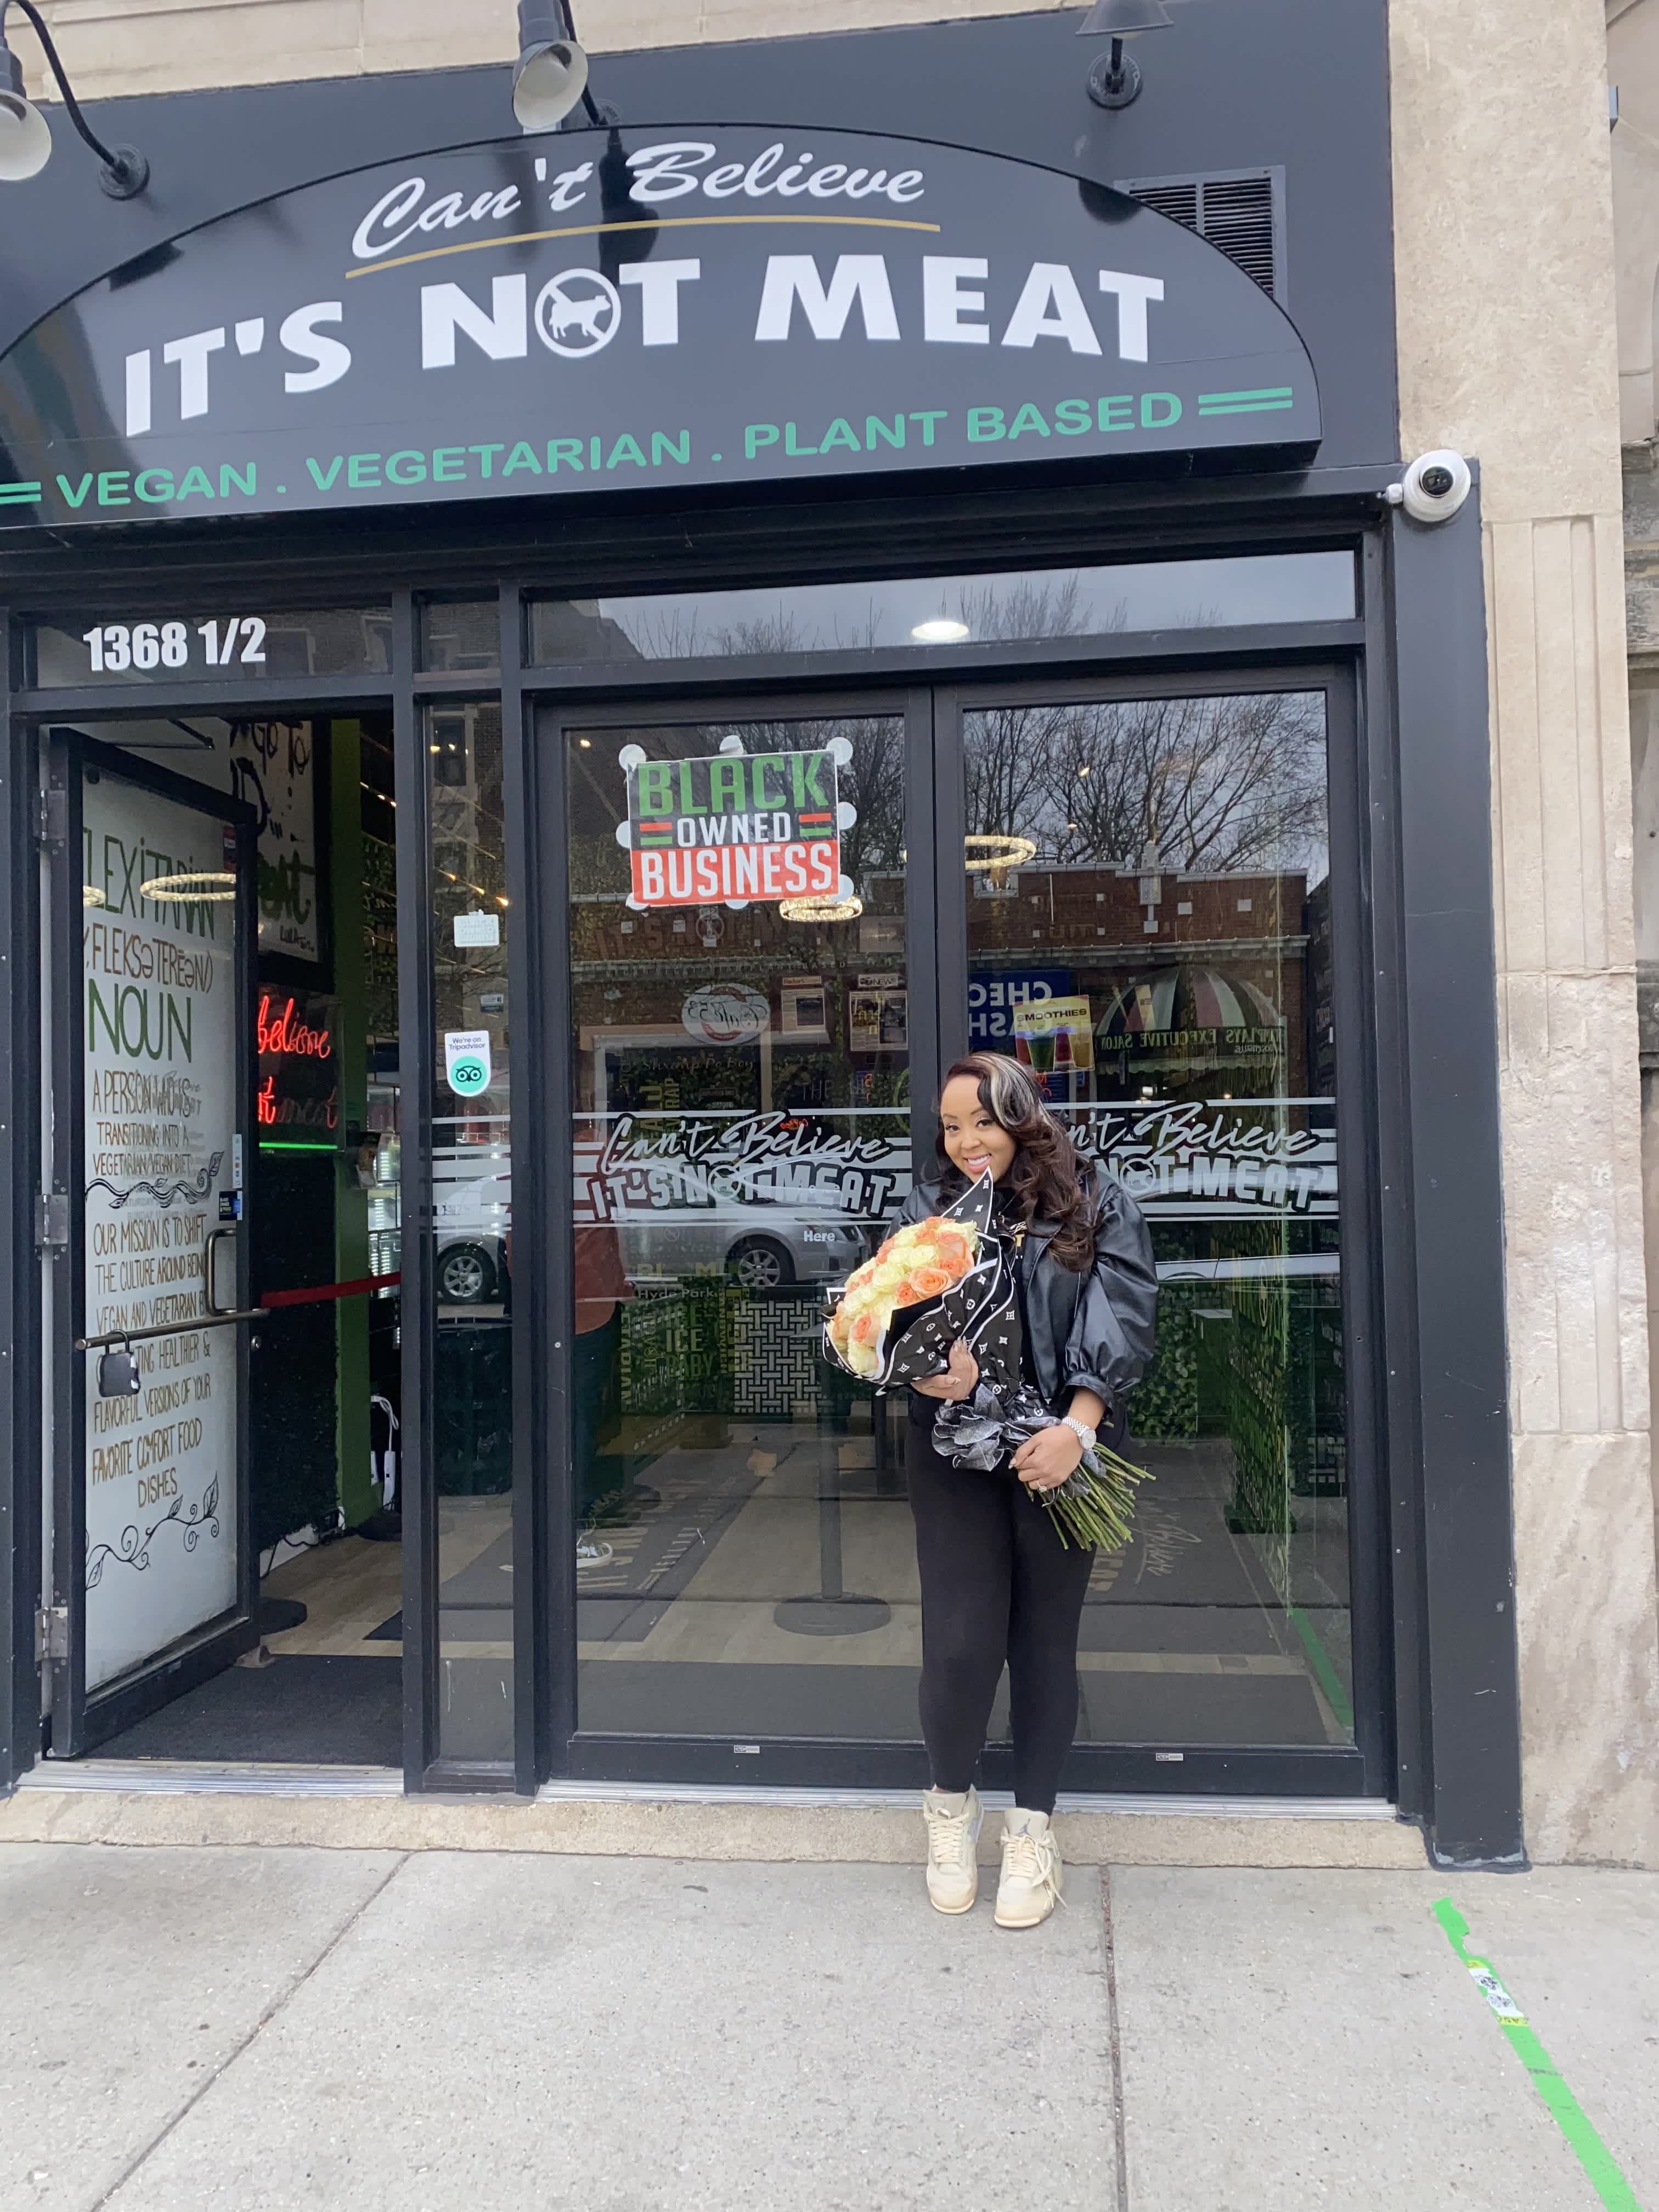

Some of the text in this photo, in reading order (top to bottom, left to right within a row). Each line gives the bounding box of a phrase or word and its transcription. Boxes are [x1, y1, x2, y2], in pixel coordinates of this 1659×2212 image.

[351, 141, 925, 260] Can't Believe
[125, 253, 1165, 438] IT'S NOT MEAT
[55, 391, 1183, 509] VEGAN VEGETARIAN PLANT BASED
[82, 617, 267, 672] 1368 1/2
[636, 753, 830, 816] BLACK
[676, 811, 792, 848] OWNED
[640, 842, 833, 900] BUSINESS
[88, 978, 192, 1064] NOUN
[1016, 1007, 1087, 1022] SMOOTHIES
[448, 1042, 486, 1051] Tripadvisor
[727, 1056, 753, 1071] Boy
[92, 1068, 102, 1114] A
[104, 1069, 151, 1115] PERSON
[96, 1121, 189, 1148] TRANSITIONING INTO A
[602, 1115, 716, 1175] Can't
[720, 1109, 890, 1169] Believe
[1066, 1101, 1318, 1159] n't Believe
[174, 1154, 191, 1175] DIET
[1192, 1155, 1318, 1209] MEAT
[591, 1168, 672, 1219] IT'S
[775, 1164, 891, 1217] MEAT
[93, 1214, 207, 1256] OUR MISSION IS TO SHIFT
[803, 1229, 836, 1243] Here
[94, 1262, 117, 1295] THE
[120, 1257, 156, 1291] CULTURE
[156, 1254, 186, 1283] AROUND
[638, 1288, 678, 1300] Hyde
[96, 1290, 207, 1337] VEGAN AND VEGETARIAN B
[97, 1331, 211, 1385] CTING HEALTHIER &
[665, 1328, 704, 1353] ICE
[94, 1373, 211, 1434] FLAVORFUL VERSIONS OF YOUR
[92, 1417, 202, 1486] FAVORITE COMFORT FOOD
[138, 1466, 178, 1508] DISHES
